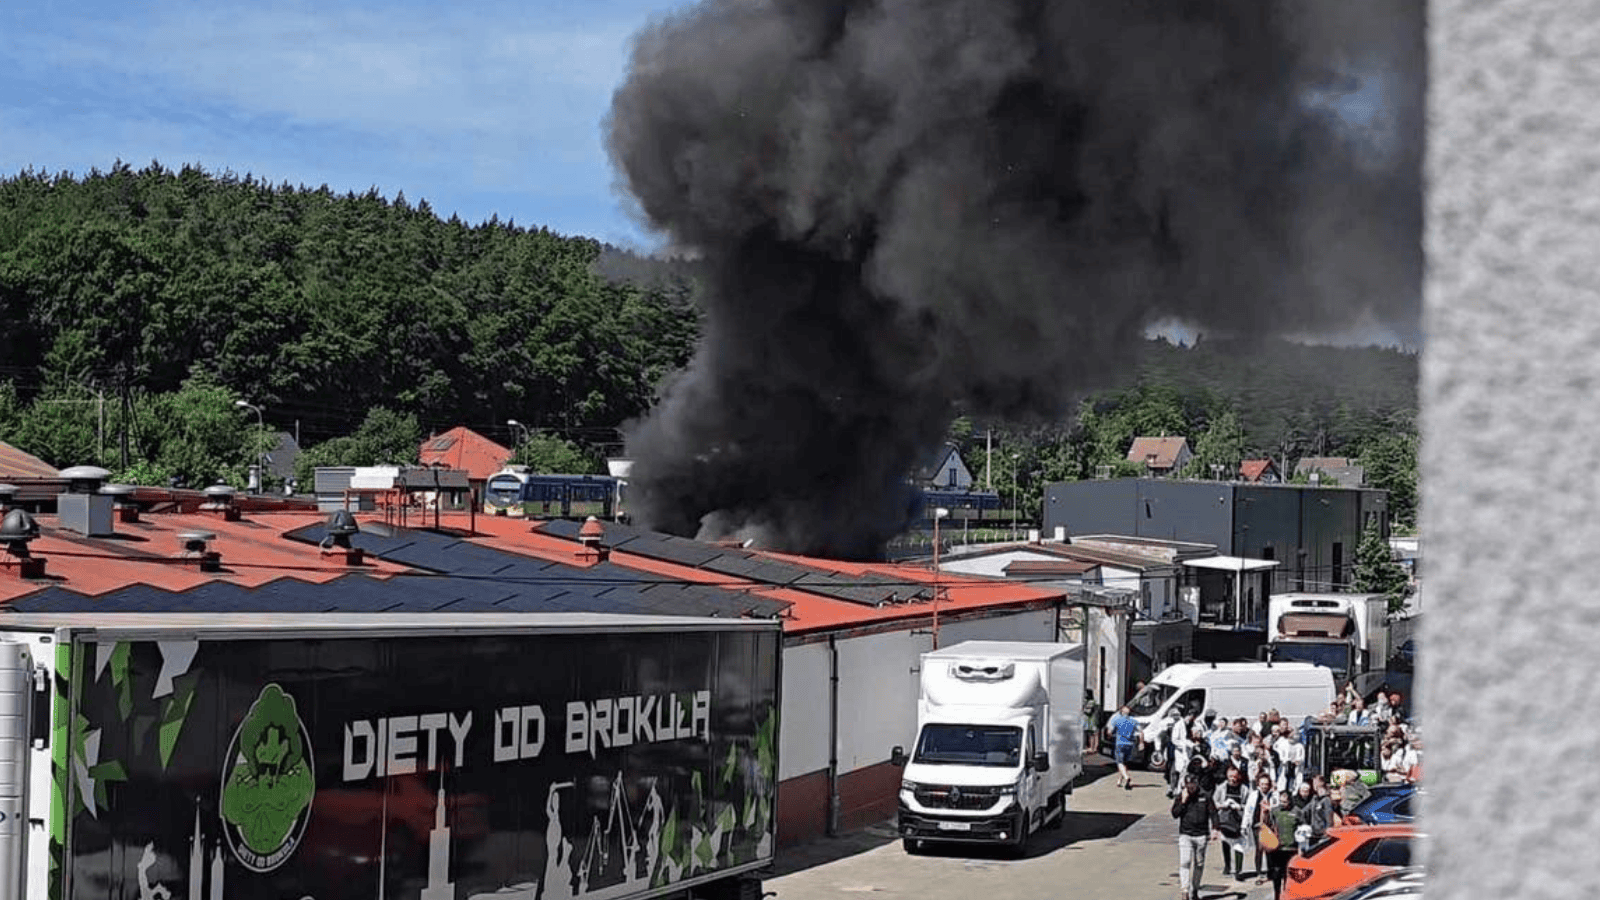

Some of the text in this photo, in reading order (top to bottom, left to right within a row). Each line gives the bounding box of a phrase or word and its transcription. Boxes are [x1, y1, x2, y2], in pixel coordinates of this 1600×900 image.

[343, 690, 710, 782] DIETY OD BROKUŁA
